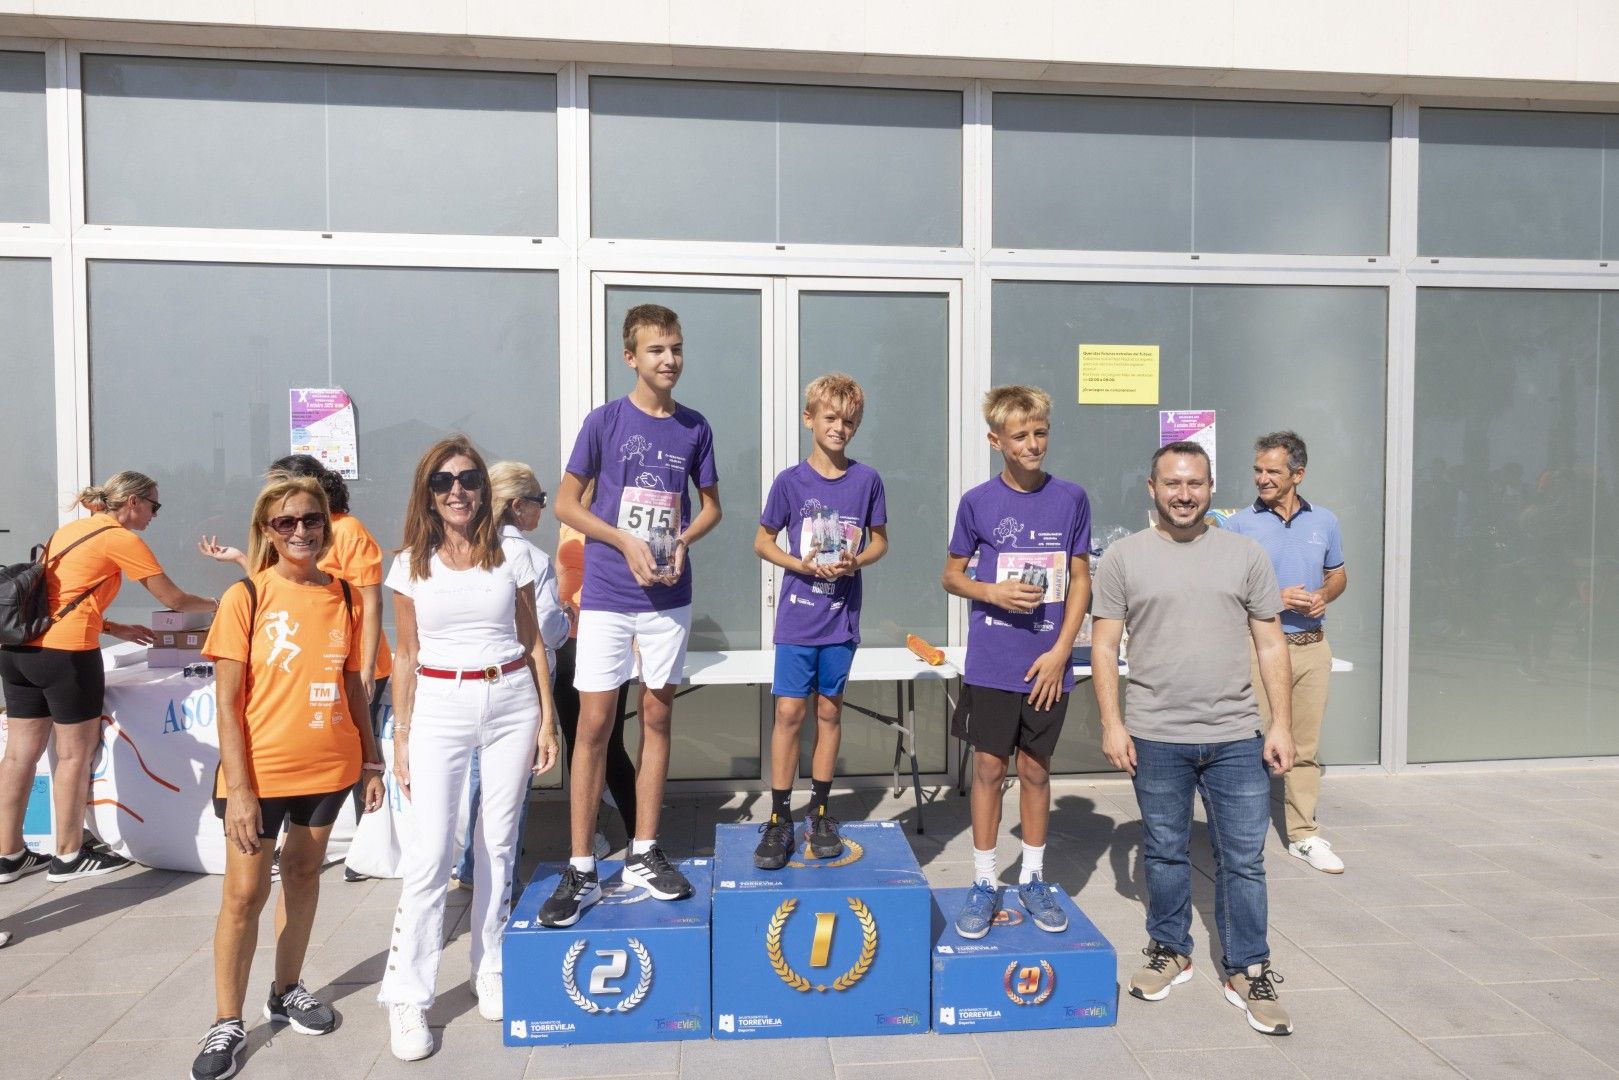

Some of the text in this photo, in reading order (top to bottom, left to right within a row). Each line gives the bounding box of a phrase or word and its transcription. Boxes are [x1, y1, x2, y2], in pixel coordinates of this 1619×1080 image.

[627, 505, 671, 532] 515
[314, 688, 330, 698] TM
[809, 913, 836, 966] 1
[589, 949, 627, 994] 2
[1017, 966, 1041, 995] 3
[738, 1018, 782, 1026] TORREVIEJA
[959, 1010, 1002, 1018] TORREVIEJA
[531, 1023, 576, 1032] TORREVIEJA
